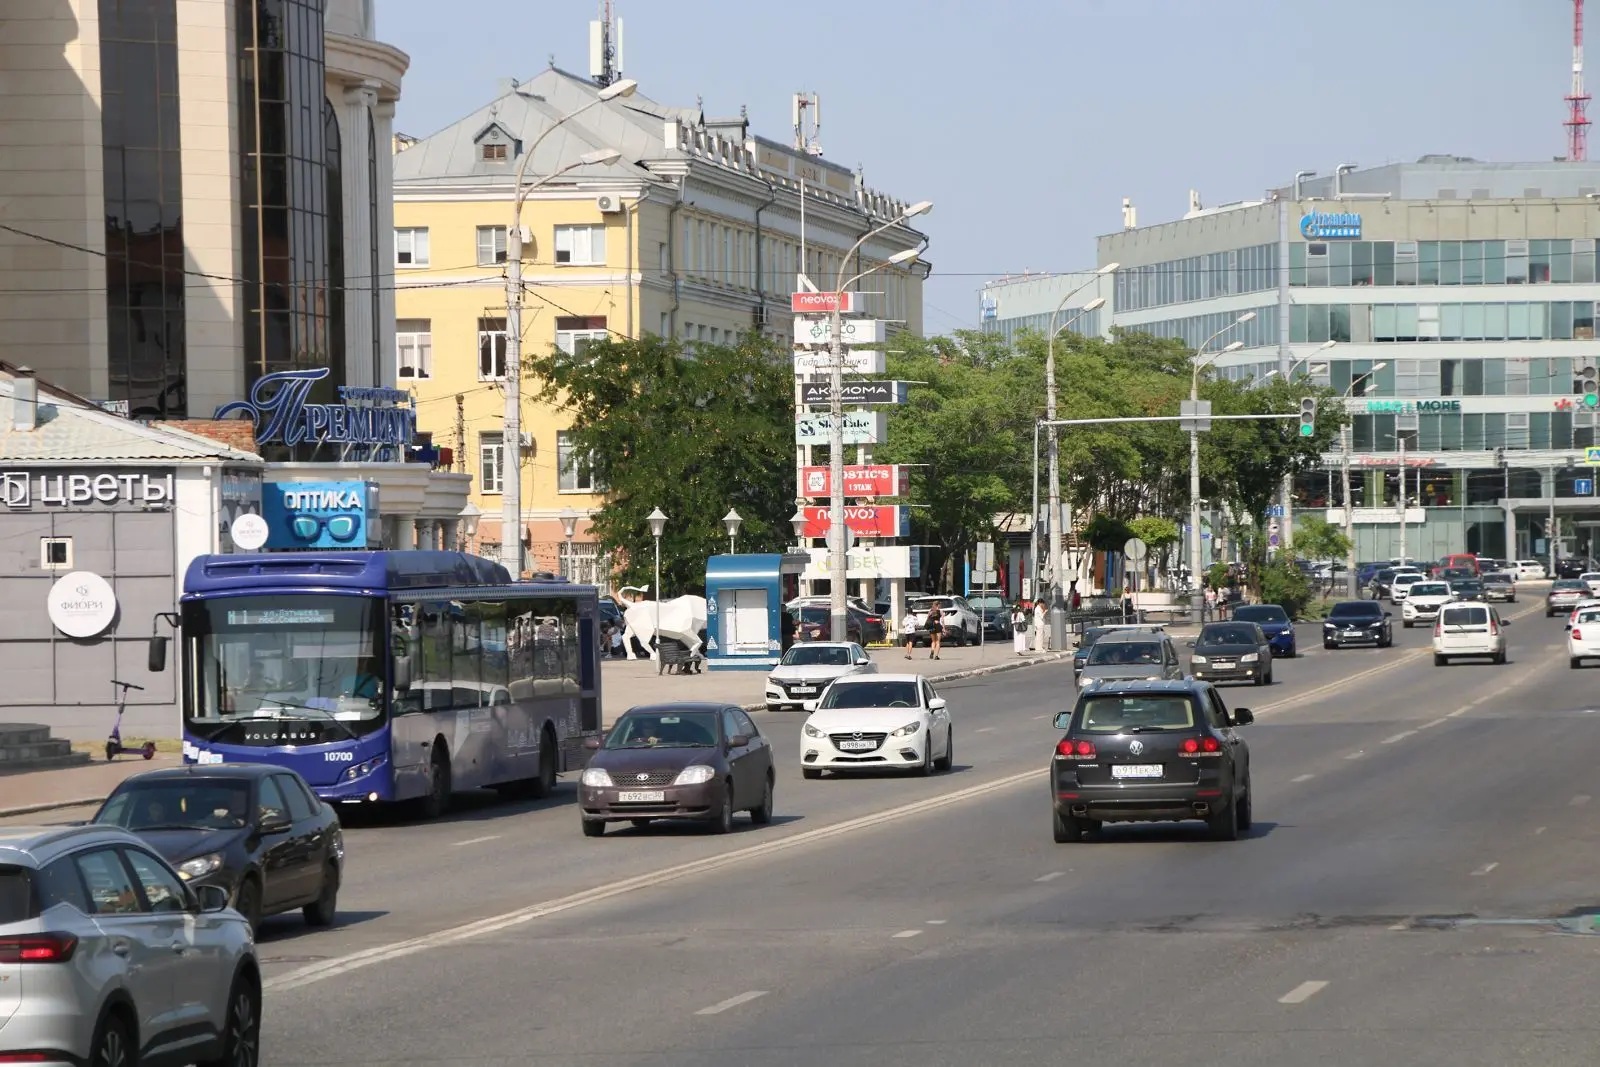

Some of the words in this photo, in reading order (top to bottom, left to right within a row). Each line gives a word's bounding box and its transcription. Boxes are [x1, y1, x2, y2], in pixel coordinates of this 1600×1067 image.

[807, 386, 887, 395] АКИОМА
[1416, 400, 1460, 410] MORE
[284, 490, 362, 509] ОПТИКА
[324, 752, 353, 761] 10700
